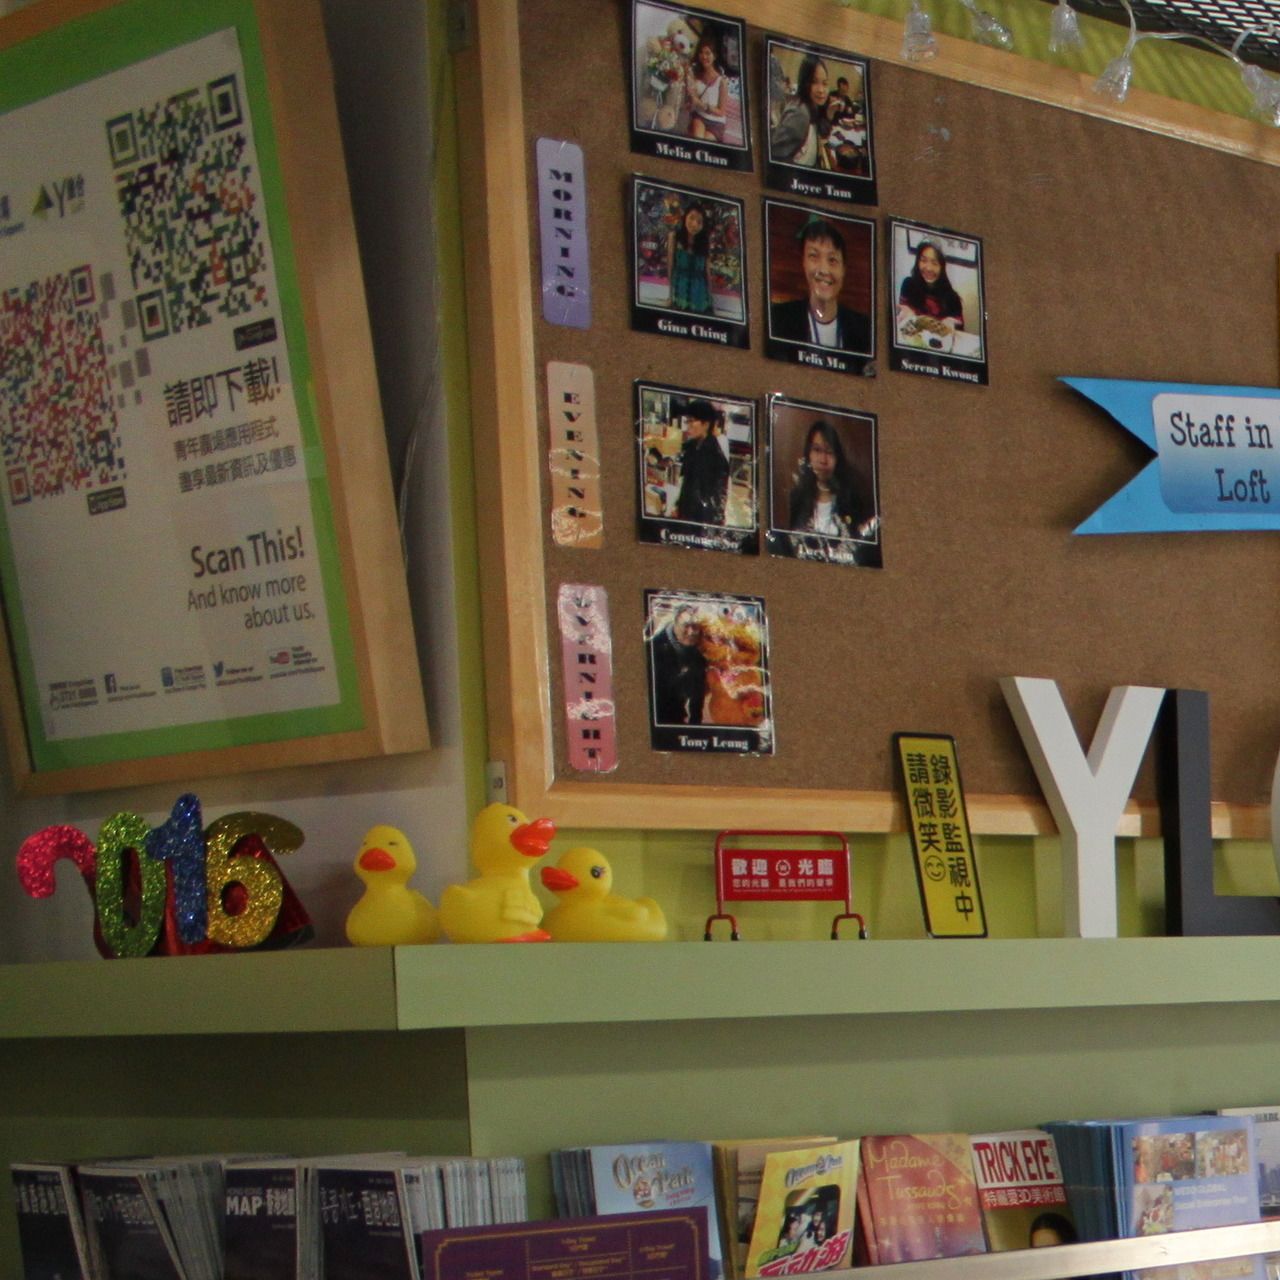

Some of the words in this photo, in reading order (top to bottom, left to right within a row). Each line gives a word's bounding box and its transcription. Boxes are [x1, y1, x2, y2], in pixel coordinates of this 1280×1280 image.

[695, 149, 728, 167] Chan
[790, 178, 822, 197] Joyce
[825, 185, 853, 200] Tam
[657, 318, 689, 336] Gina
[691, 324, 728, 344] Ching
[797, 349, 823, 368] Felix
[824, 356, 847, 371] Ma
[900, 358, 941, 376] Serena
[942, 364, 979, 384] Kwong
[162, 356, 281, 428] 請即下載!
[1169, 411, 1235, 448] Staff
[1245, 416, 1273, 450] in
[1215, 468, 1271, 503] Loft
[190, 545, 246, 579] Scan
[246, 525, 305, 568] This!
[187, 584, 218, 612] And
[219, 582, 261, 607] know
[265, 573, 307, 599] more
[244, 603, 290, 630] about
[293, 601, 316, 621] us.
[678, 735, 709, 752] Tony
[711, 736, 749, 753] Leung
[906, 752, 943, 854] 請微笑
[867, 1139, 942, 1173] Madame
[973, 1141, 1026, 1184] TRICK
[1020, 1139, 1056, 1181] EYE
[226, 1195, 263, 1216] MAP
[874, 1168, 963, 1211] Tussauds
